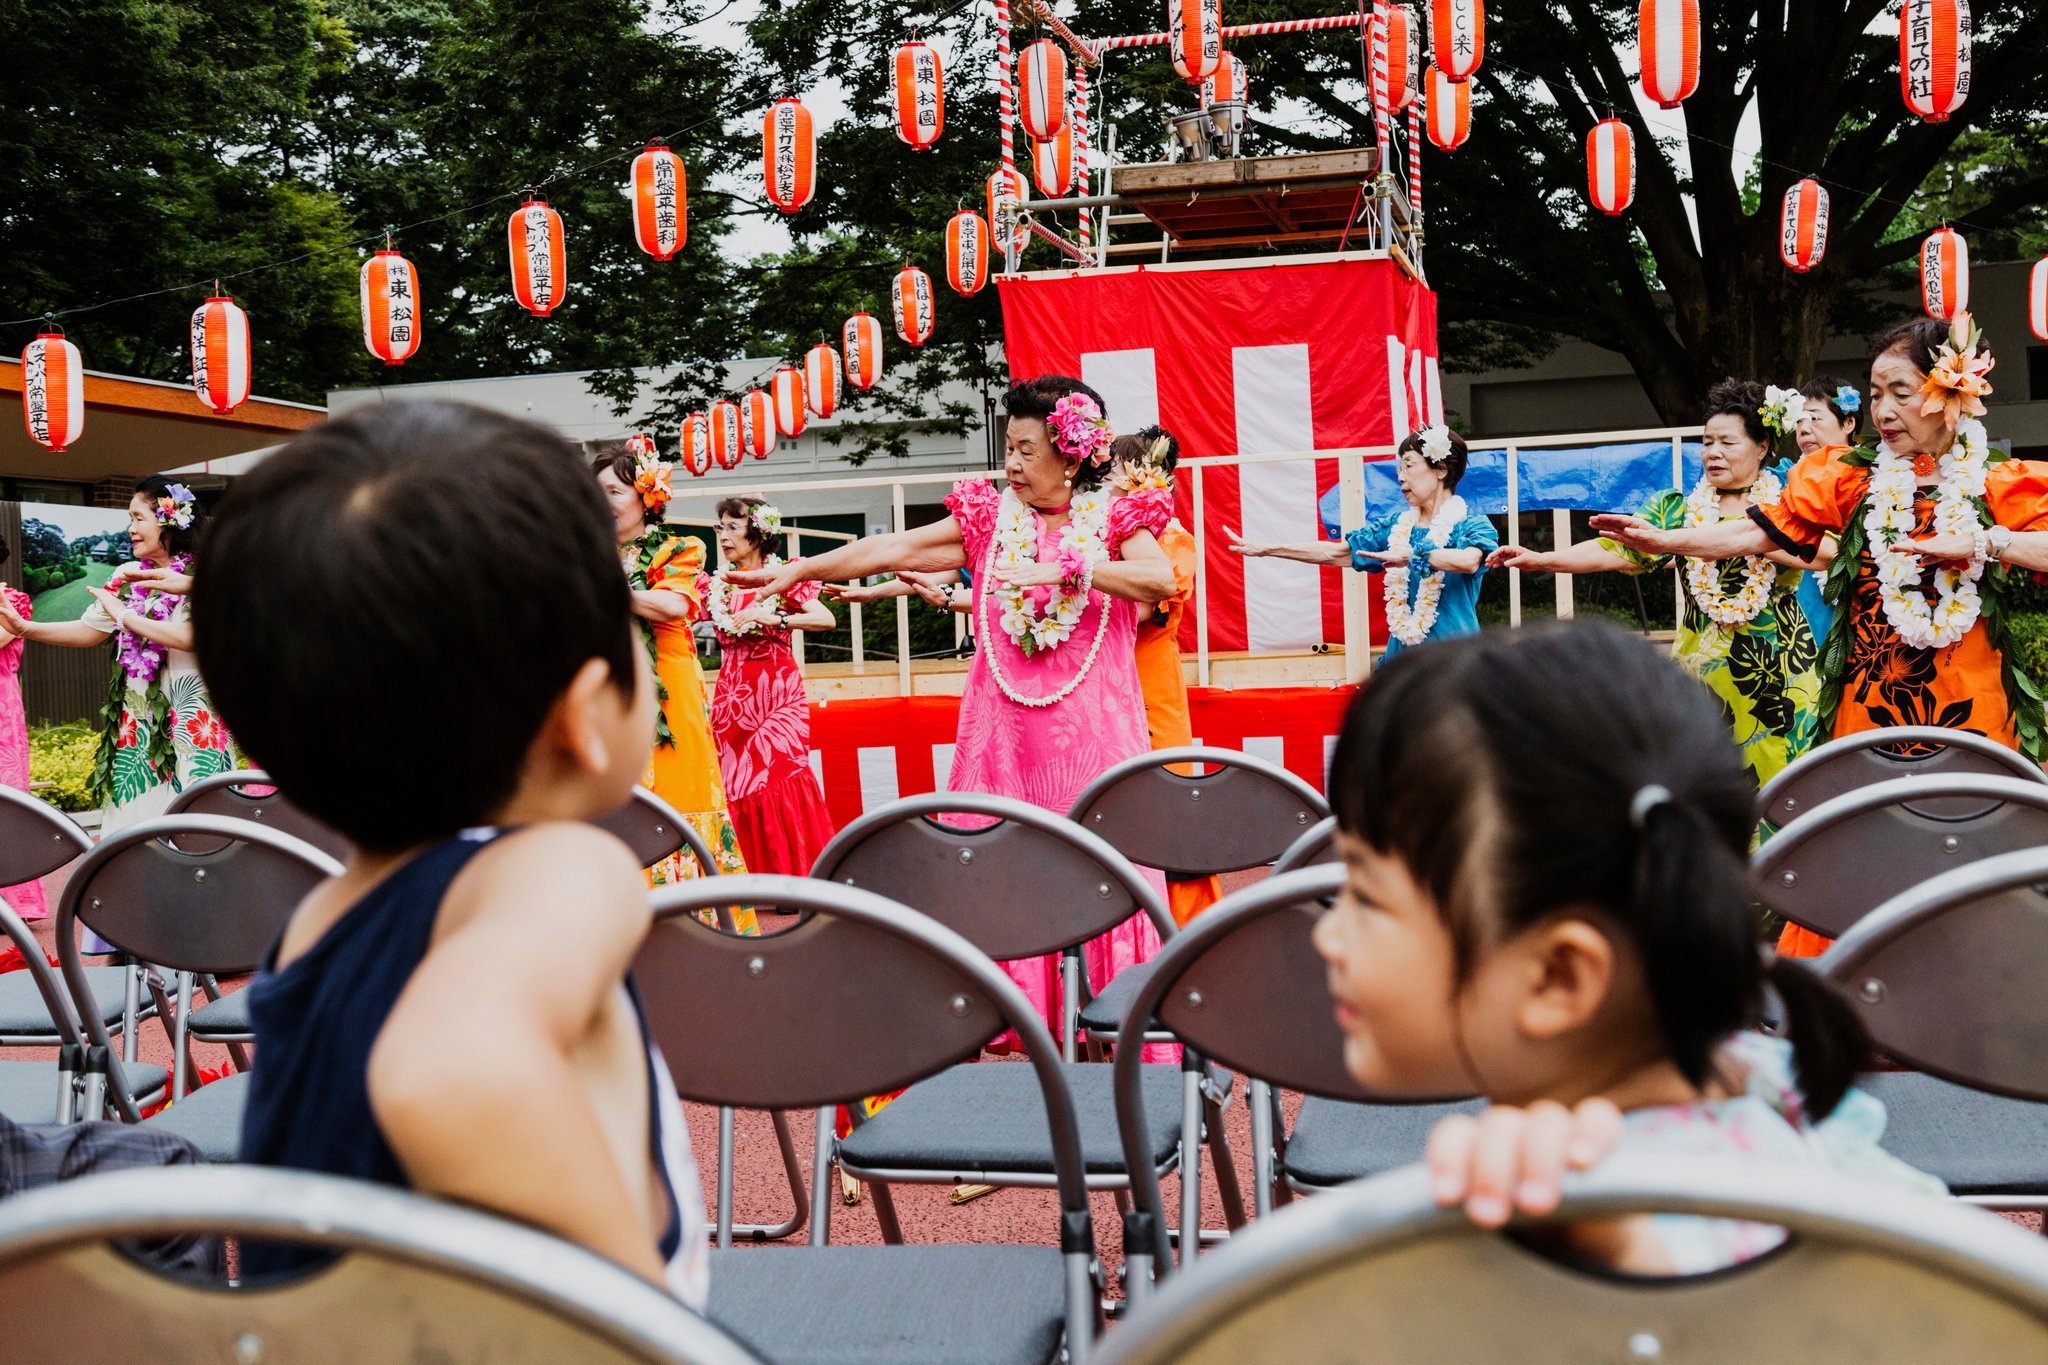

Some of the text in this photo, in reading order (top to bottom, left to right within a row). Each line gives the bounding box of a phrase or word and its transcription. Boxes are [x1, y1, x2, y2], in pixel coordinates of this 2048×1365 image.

[655, 158, 677, 245] 常盤平歯科
[531, 251, 553, 306] 常盤平店
[961, 217, 977, 289] 東京東信用金庫
[915, 275, 932, 334] ほほえみ
